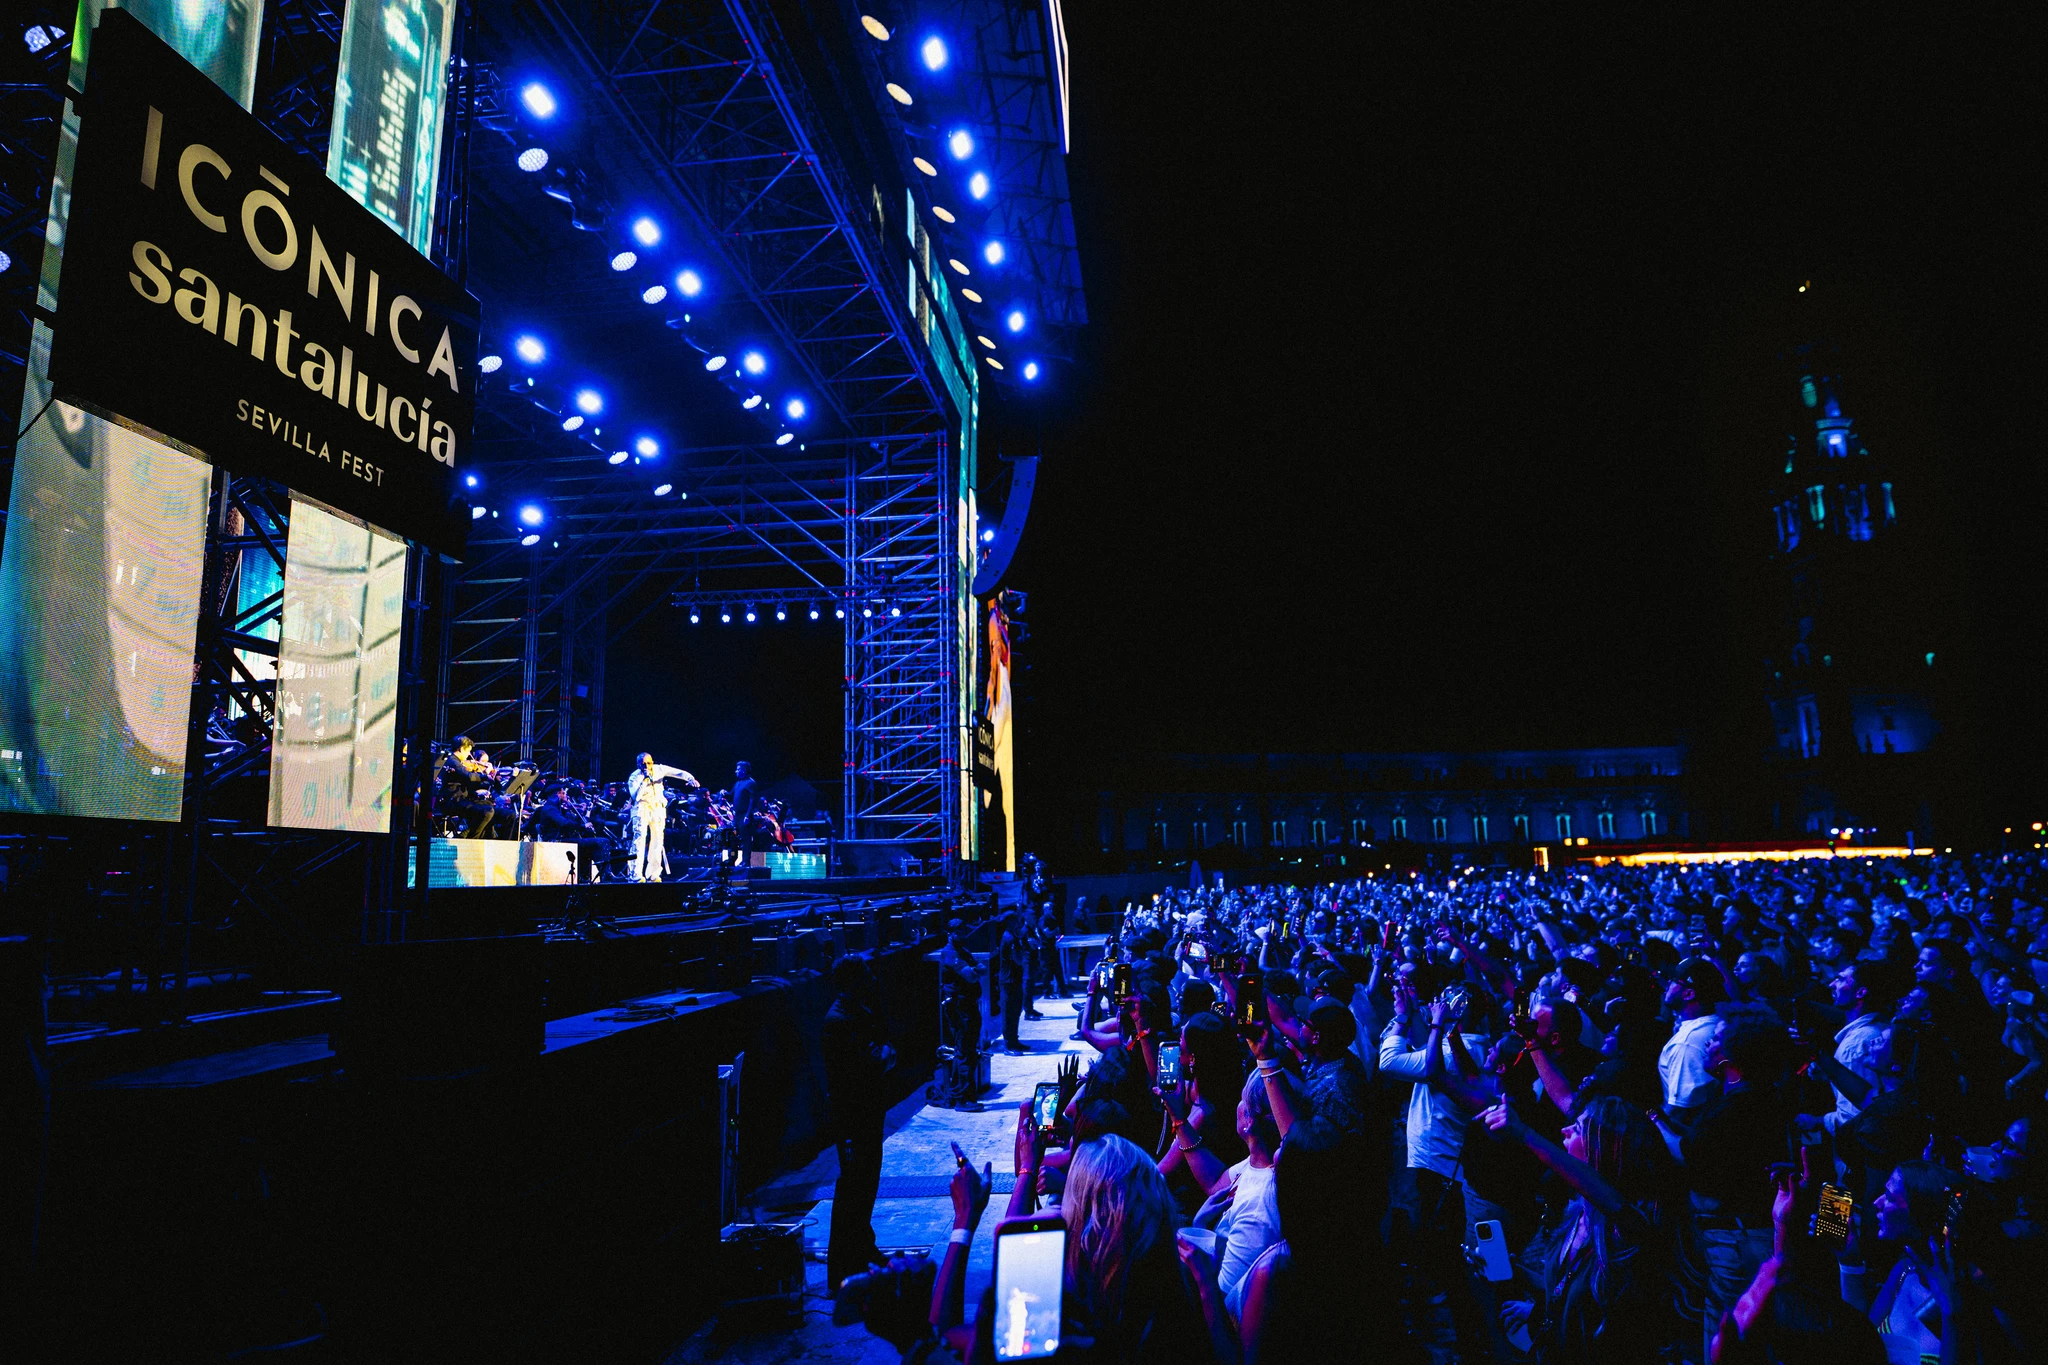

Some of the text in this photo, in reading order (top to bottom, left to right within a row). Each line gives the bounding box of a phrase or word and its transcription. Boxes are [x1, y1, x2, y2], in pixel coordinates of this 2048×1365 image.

[128, 240, 457, 468] santalucía
[236, 398, 386, 489] SEVILLA FEST
